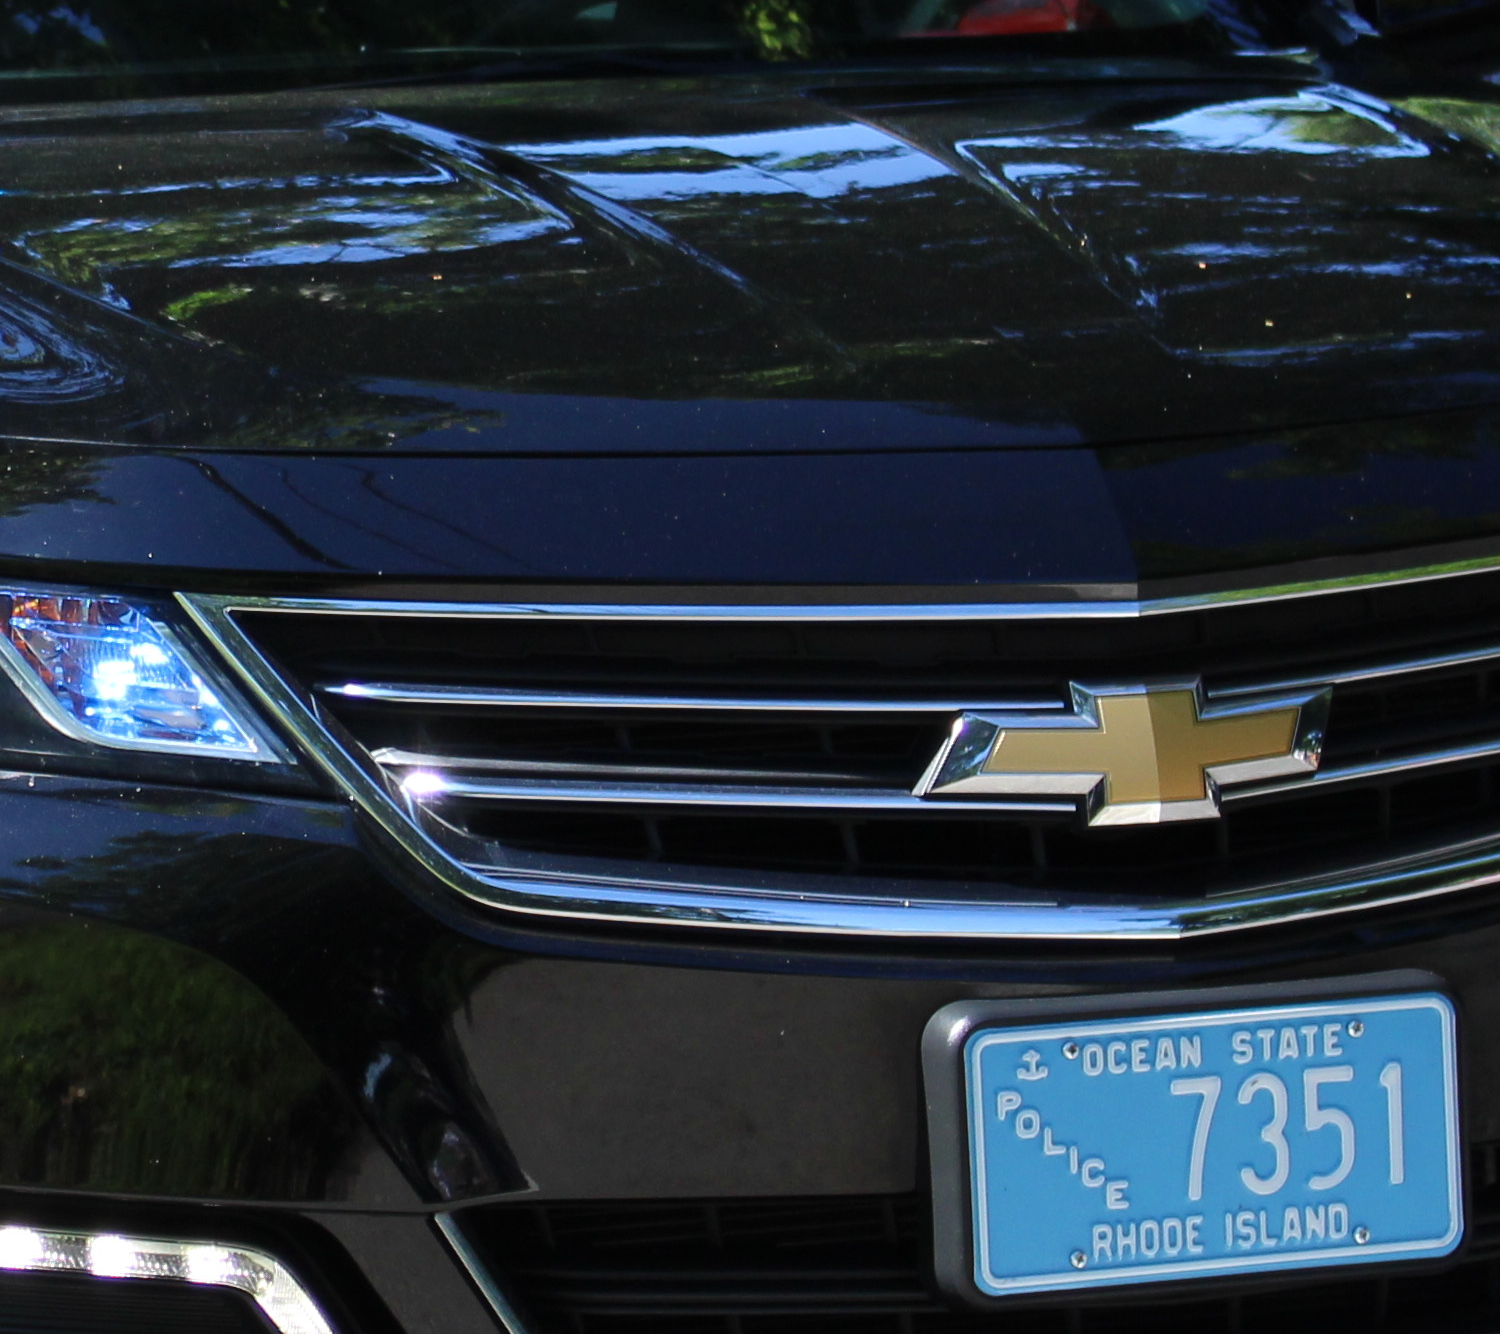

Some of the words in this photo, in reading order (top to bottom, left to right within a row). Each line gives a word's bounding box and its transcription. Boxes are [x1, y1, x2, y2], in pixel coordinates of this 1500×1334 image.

[1082, 1035, 1201, 1078] OCEAN
[1231, 1022, 1344, 1065] STATE
[997, 1090, 1130, 1210] POLICE
[1170, 1062, 1404, 1201] 7351
[1091, 1214, 1204, 1261] RHODE
[1225, 1202, 1349, 1249] ISLAND
